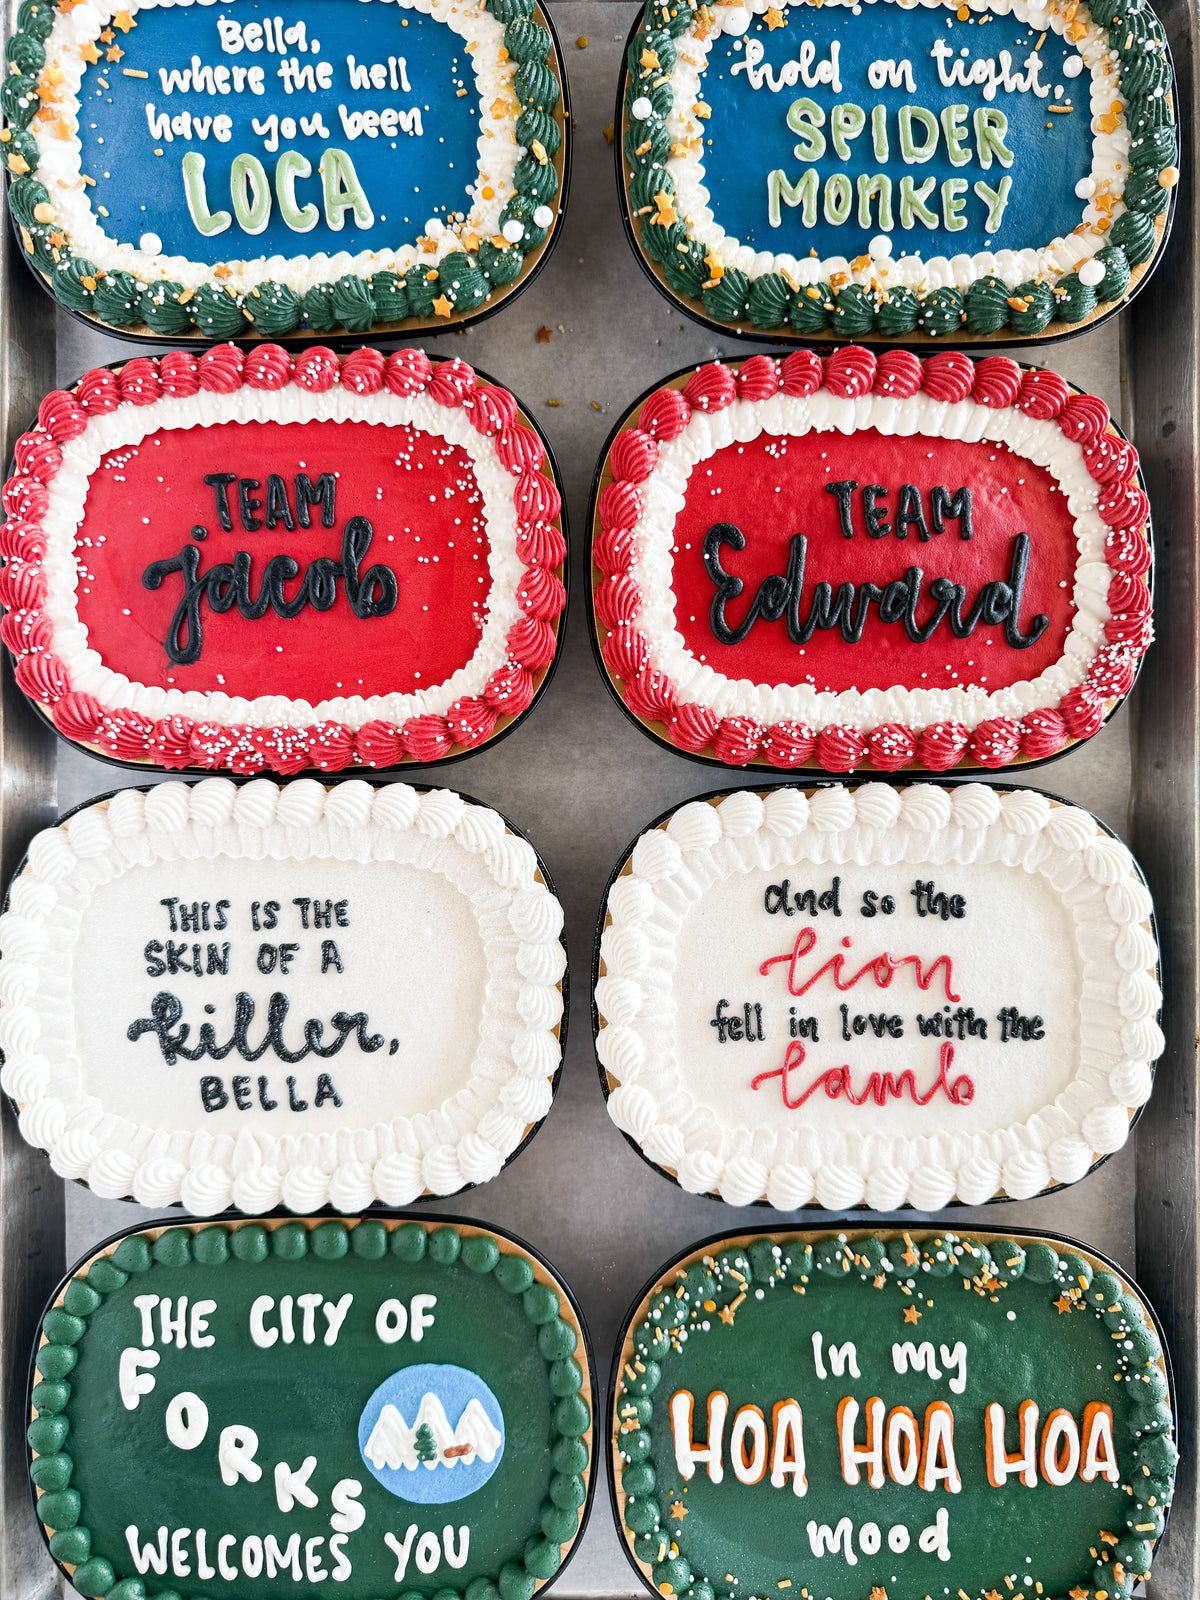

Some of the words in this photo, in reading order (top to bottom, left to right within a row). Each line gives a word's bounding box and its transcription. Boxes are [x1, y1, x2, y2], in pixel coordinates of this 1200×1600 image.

[218, 16, 320, 54] Bella,
[159, 56, 265, 95] where
[278, 57, 333, 92] the
[347, 55, 411, 91] hell
[731, 38, 842, 92] hold
[868, 59, 917, 92] on
[146, 104, 232, 142] have
[252, 112, 329, 152] you
[339, 104, 424, 141] been
[787, 98, 1014, 169] SPIDER
[182, 148, 374, 236] LOCA
[204, 473, 336, 531] TEAM
[825, 480, 973, 542] TEAM
[142, 516, 398, 666] jacob
[702, 522, 1049, 648] Edward
[160, 897, 231, 932] THIS
[252, 900, 280, 931] IS
[293, 898, 351, 929] THE
[765, 877, 842, 917] and
[861, 889, 895, 917] so
[911, 880, 966, 920] the
[144, 940, 231, 977] SKIN
[257, 943, 300, 975] OF
[322, 940, 344, 974] A
[759, 927, 960, 1002] lion
[128, 991, 399, 1066] killer,
[710, 999, 766, 1043] fell
[789, 1008, 819, 1042] in
[840, 1004, 904, 1041] love
[916, 1006, 987, 1042] with
[997, 1006, 1045, 1042] the
[201, 1073, 343, 1112] BELLA
[751, 1041, 975, 1109] lamb
[134, 1294, 217, 1349] THE
[249, 1293, 353, 1348] CITY
[375, 1294, 437, 1343] OF
[811, 1331, 860, 1379] In
[892, 1341, 967, 1394] my
[119, 1347, 366, 1532] FORKS
[669, 1389, 808, 1497] HOA
[837, 1396, 962, 1493] HOA
[985, 1400, 1120, 1488] HOA
[125, 1524, 352, 1582] WELCOMES
[384, 1524, 470, 1582] YOU
[807, 1508, 951, 1565] mood
